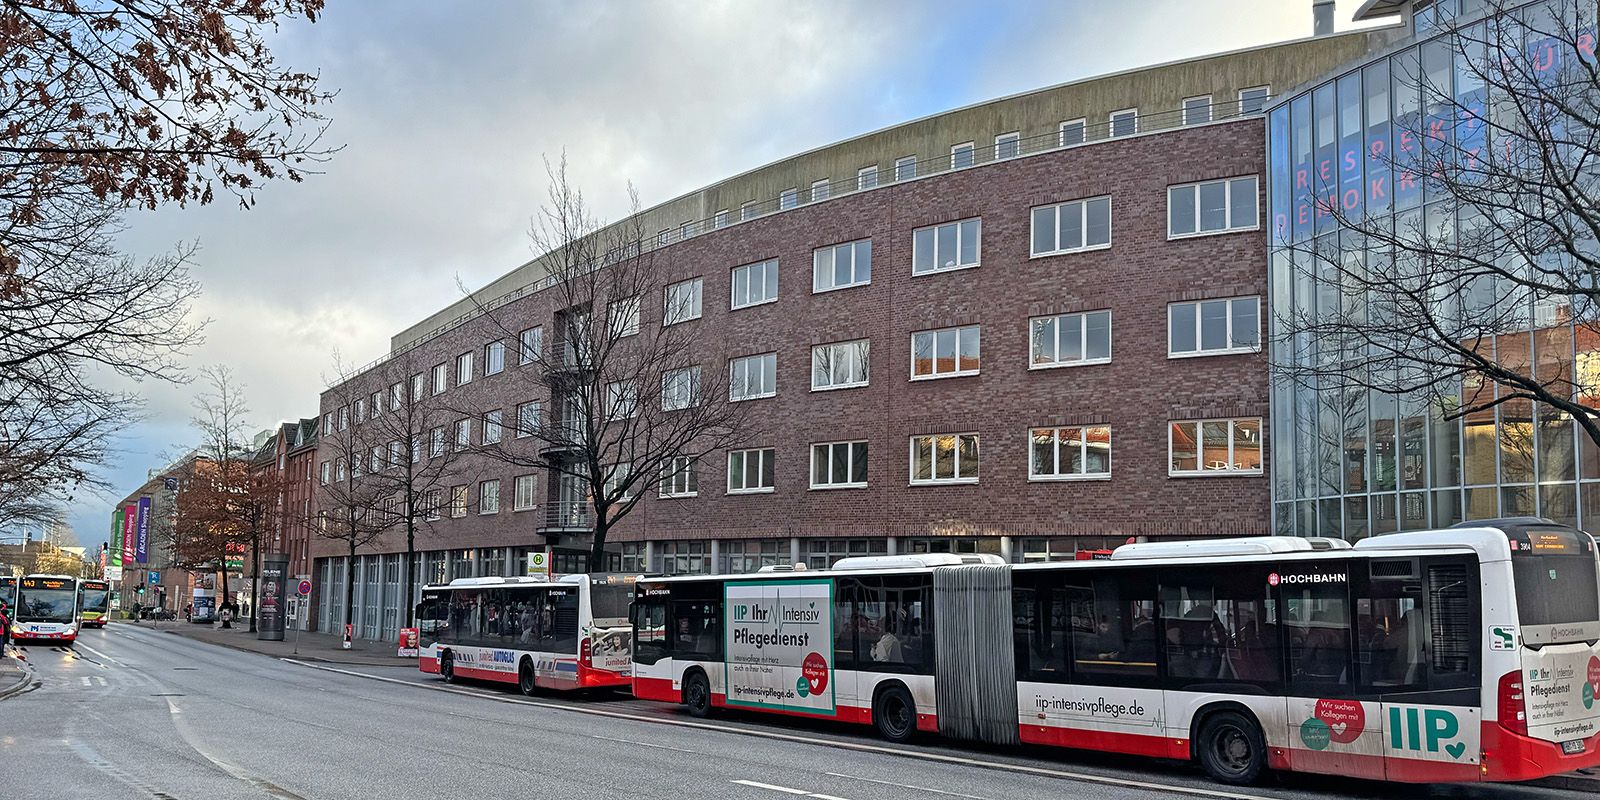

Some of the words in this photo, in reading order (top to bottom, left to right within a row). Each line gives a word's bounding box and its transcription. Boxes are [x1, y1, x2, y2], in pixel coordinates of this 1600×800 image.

[1297, 109, 1480, 190] RESPEKT
[1276, 136, 1514, 232] DEMOKRTI
[1280, 574, 1346, 584] HOCHBAHN
[734, 605, 748, 620] IIP
[752, 604, 768, 620] Ihr
[782, 605, 820, 621] Intensiv
[734, 628, 809, 649] Pflegedienst
[494, 650, 514, 664] AUTOGLAS
[606, 657, 628, 667] junited
[1530, 669, 1538, 680] IIP
[1540, 668, 1550, 679] Ihr
[1557, 667, 1574, 677] Intensiv
[734, 684, 794, 699] iip-intensivpflege.de
[1531, 683, 1570, 698] Pflegedienst
[1036, 694, 1144, 718] iip-intensivpflege.de
[1320, 701, 1333, 709] Wir
[1334, 702, 1355, 712] suchen
[1321, 709, 1348, 720] Kollegen
[1348, 712, 1359, 721] mit
[1389, 706, 1459, 752] IIP
[1554, 722, 1594, 737] iip-intensivpflege.de
